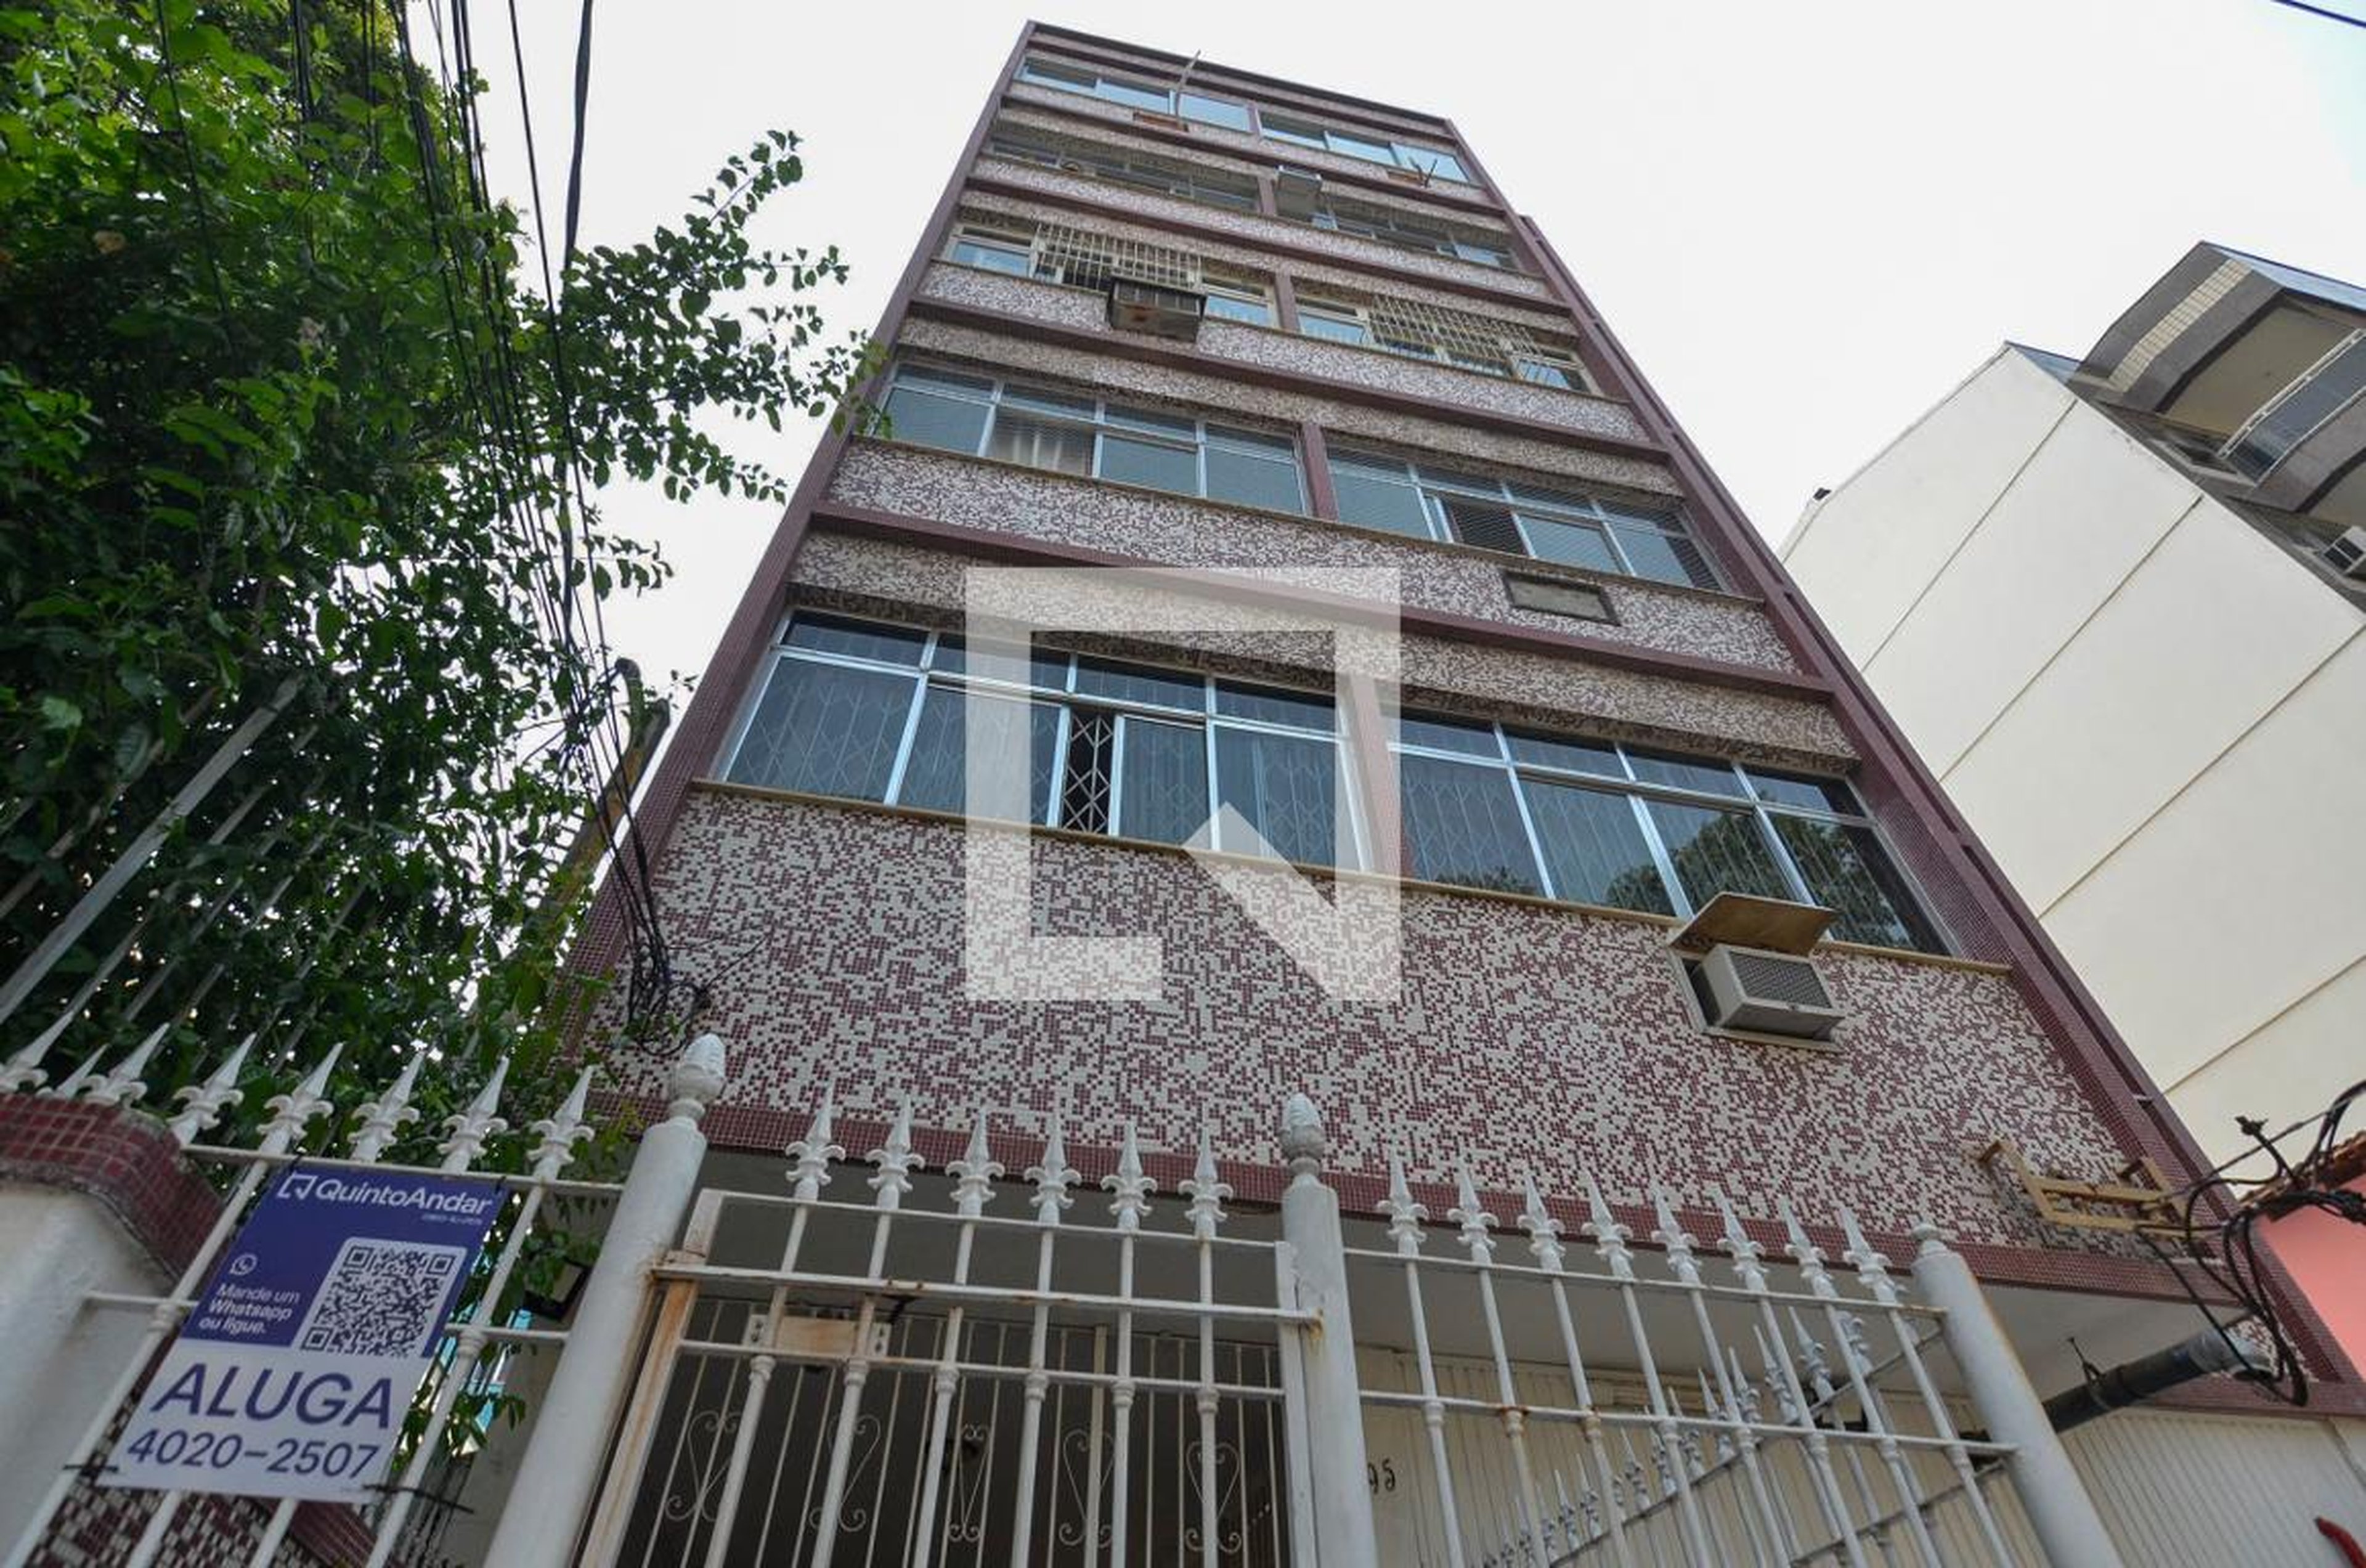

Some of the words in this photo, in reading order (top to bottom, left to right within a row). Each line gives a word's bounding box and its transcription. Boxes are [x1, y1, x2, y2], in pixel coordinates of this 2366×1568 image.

[315, 1177, 492, 1215] QuintoAndar
[274, 1291, 301, 1304] um
[199, 1317, 221, 1329] ou
[150, 1363, 392, 1429] ALUGA
[127, 1428, 380, 1479] 4020-2507
